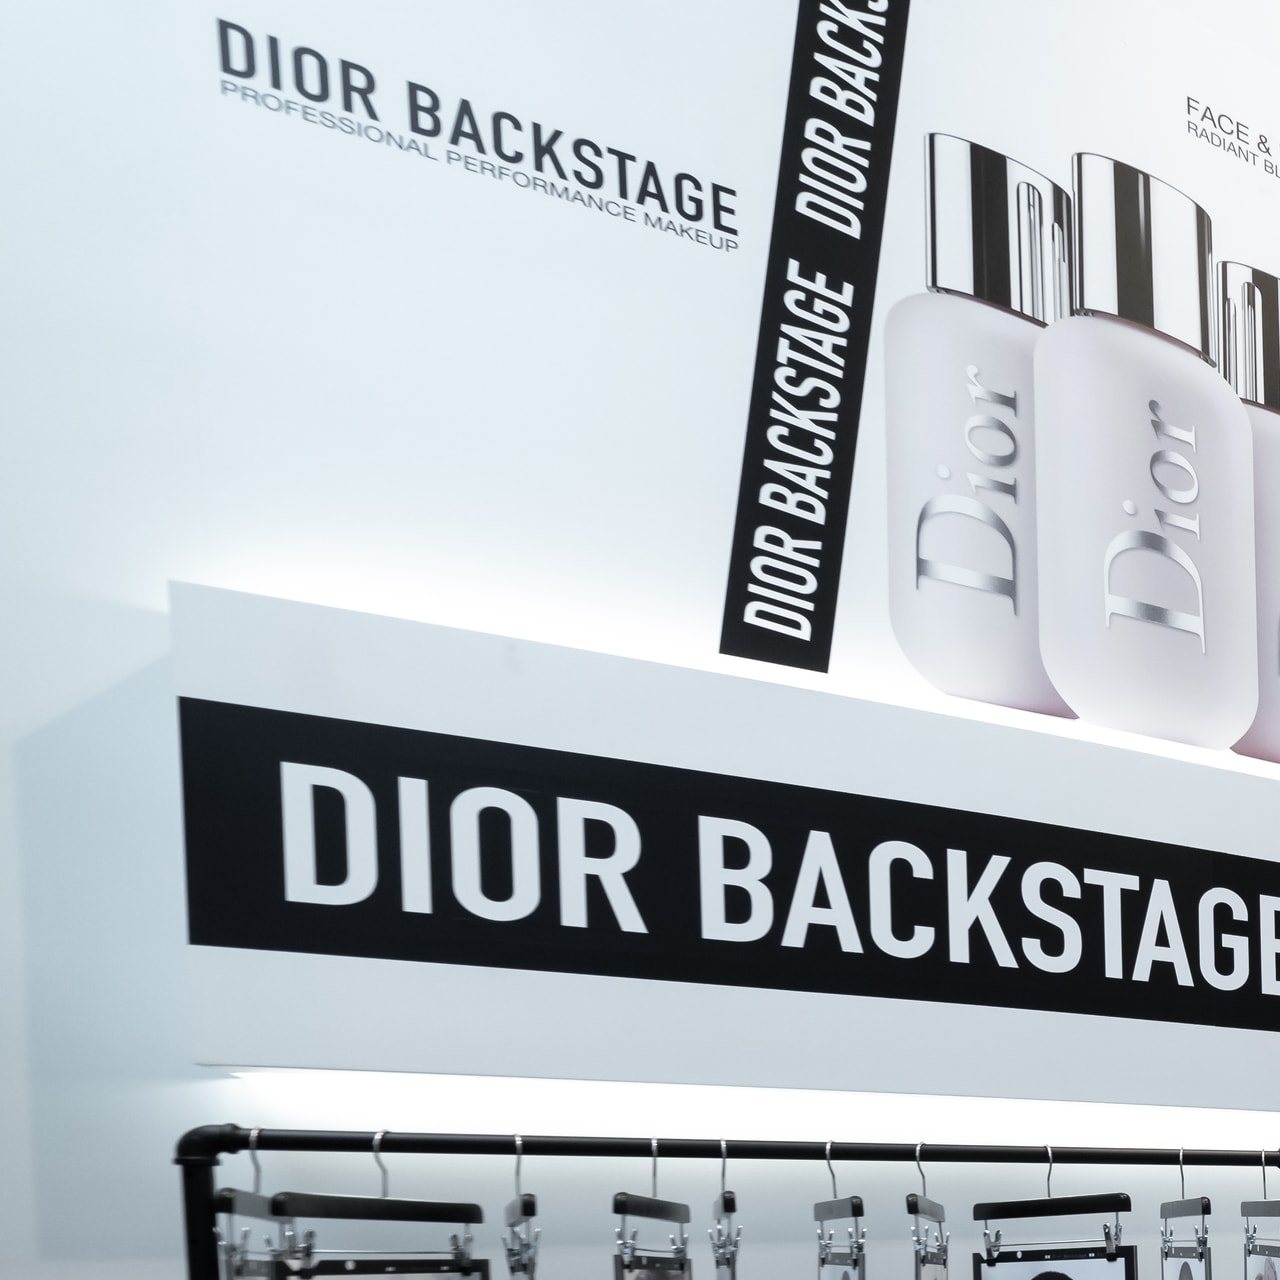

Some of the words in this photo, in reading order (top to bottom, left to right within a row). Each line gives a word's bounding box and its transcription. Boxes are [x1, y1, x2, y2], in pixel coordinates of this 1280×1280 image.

[216, 17, 380, 122] DIOR
[407, 80, 740, 237] BACKSTAGE
[220, 79, 438, 162] PROFESSIONAL
[446, 150, 637, 224] PERFORMANCE
[643, 212, 739, 254] MAKEUP
[795, 117, 871, 240] DIOR
[1186, 95, 1250, 146] FACE
[1257, 134, 1272, 157] &
[1187, 120, 1259, 166] RADIANT
[758, 257, 854, 526] BACKSTAGE
[915, 363, 1020, 619] Dior
[1103, 398, 1208, 656] Dior
[742, 523, 823, 643] DIOR
[278, 760, 649, 935] DIOR
